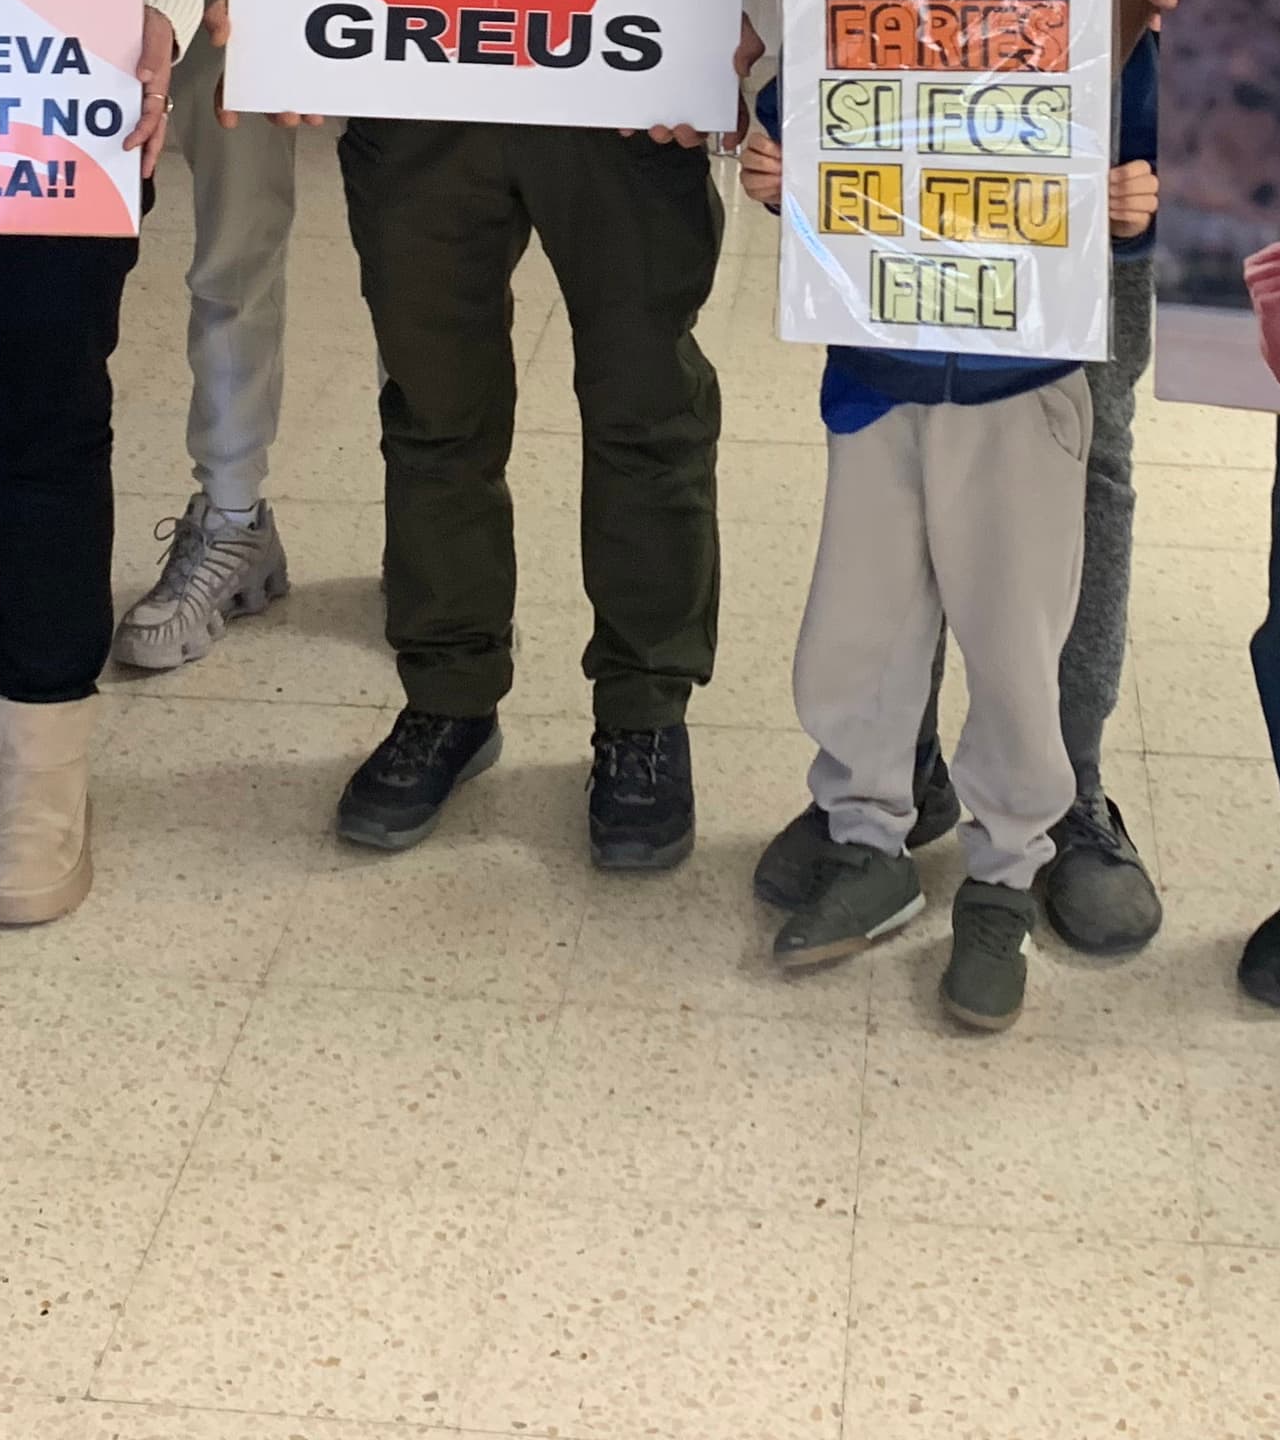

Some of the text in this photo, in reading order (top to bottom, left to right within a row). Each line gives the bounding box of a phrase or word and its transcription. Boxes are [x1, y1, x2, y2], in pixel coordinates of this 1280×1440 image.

[305, 2, 663, 72] GREUS
[830, 2, 1065, 70] FARIES
[42, 98, 122, 137] NO
[826, 81, 1067, 153] SI FOS
[824, 170, 1063, 241] EL TEU
[878, 256, 1016, 328] FILL
